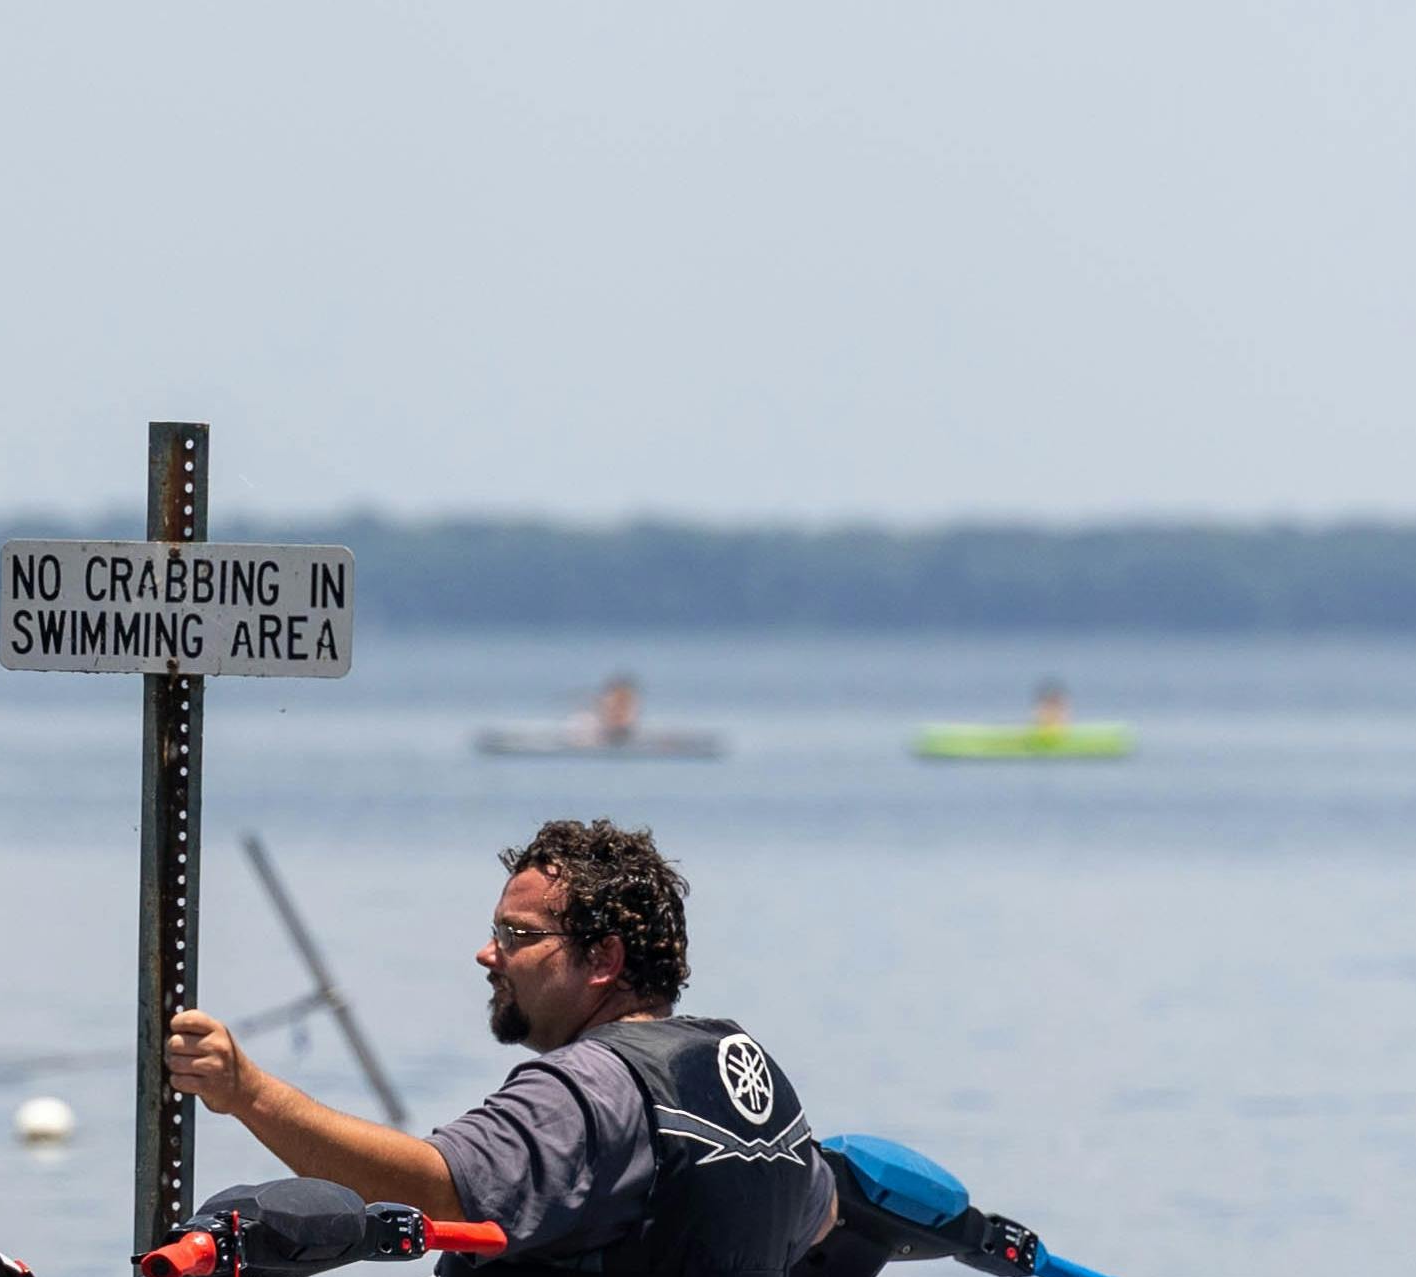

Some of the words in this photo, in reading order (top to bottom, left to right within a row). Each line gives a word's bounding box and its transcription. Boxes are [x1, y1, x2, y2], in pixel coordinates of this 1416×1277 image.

[11, 554, 62, 602] NO
[84, 555, 281, 607] CRABBING
[310, 562, 346, 609] IN
[10, 609, 204, 660] SWIMMING
[230, 614, 339, 662] AREA
